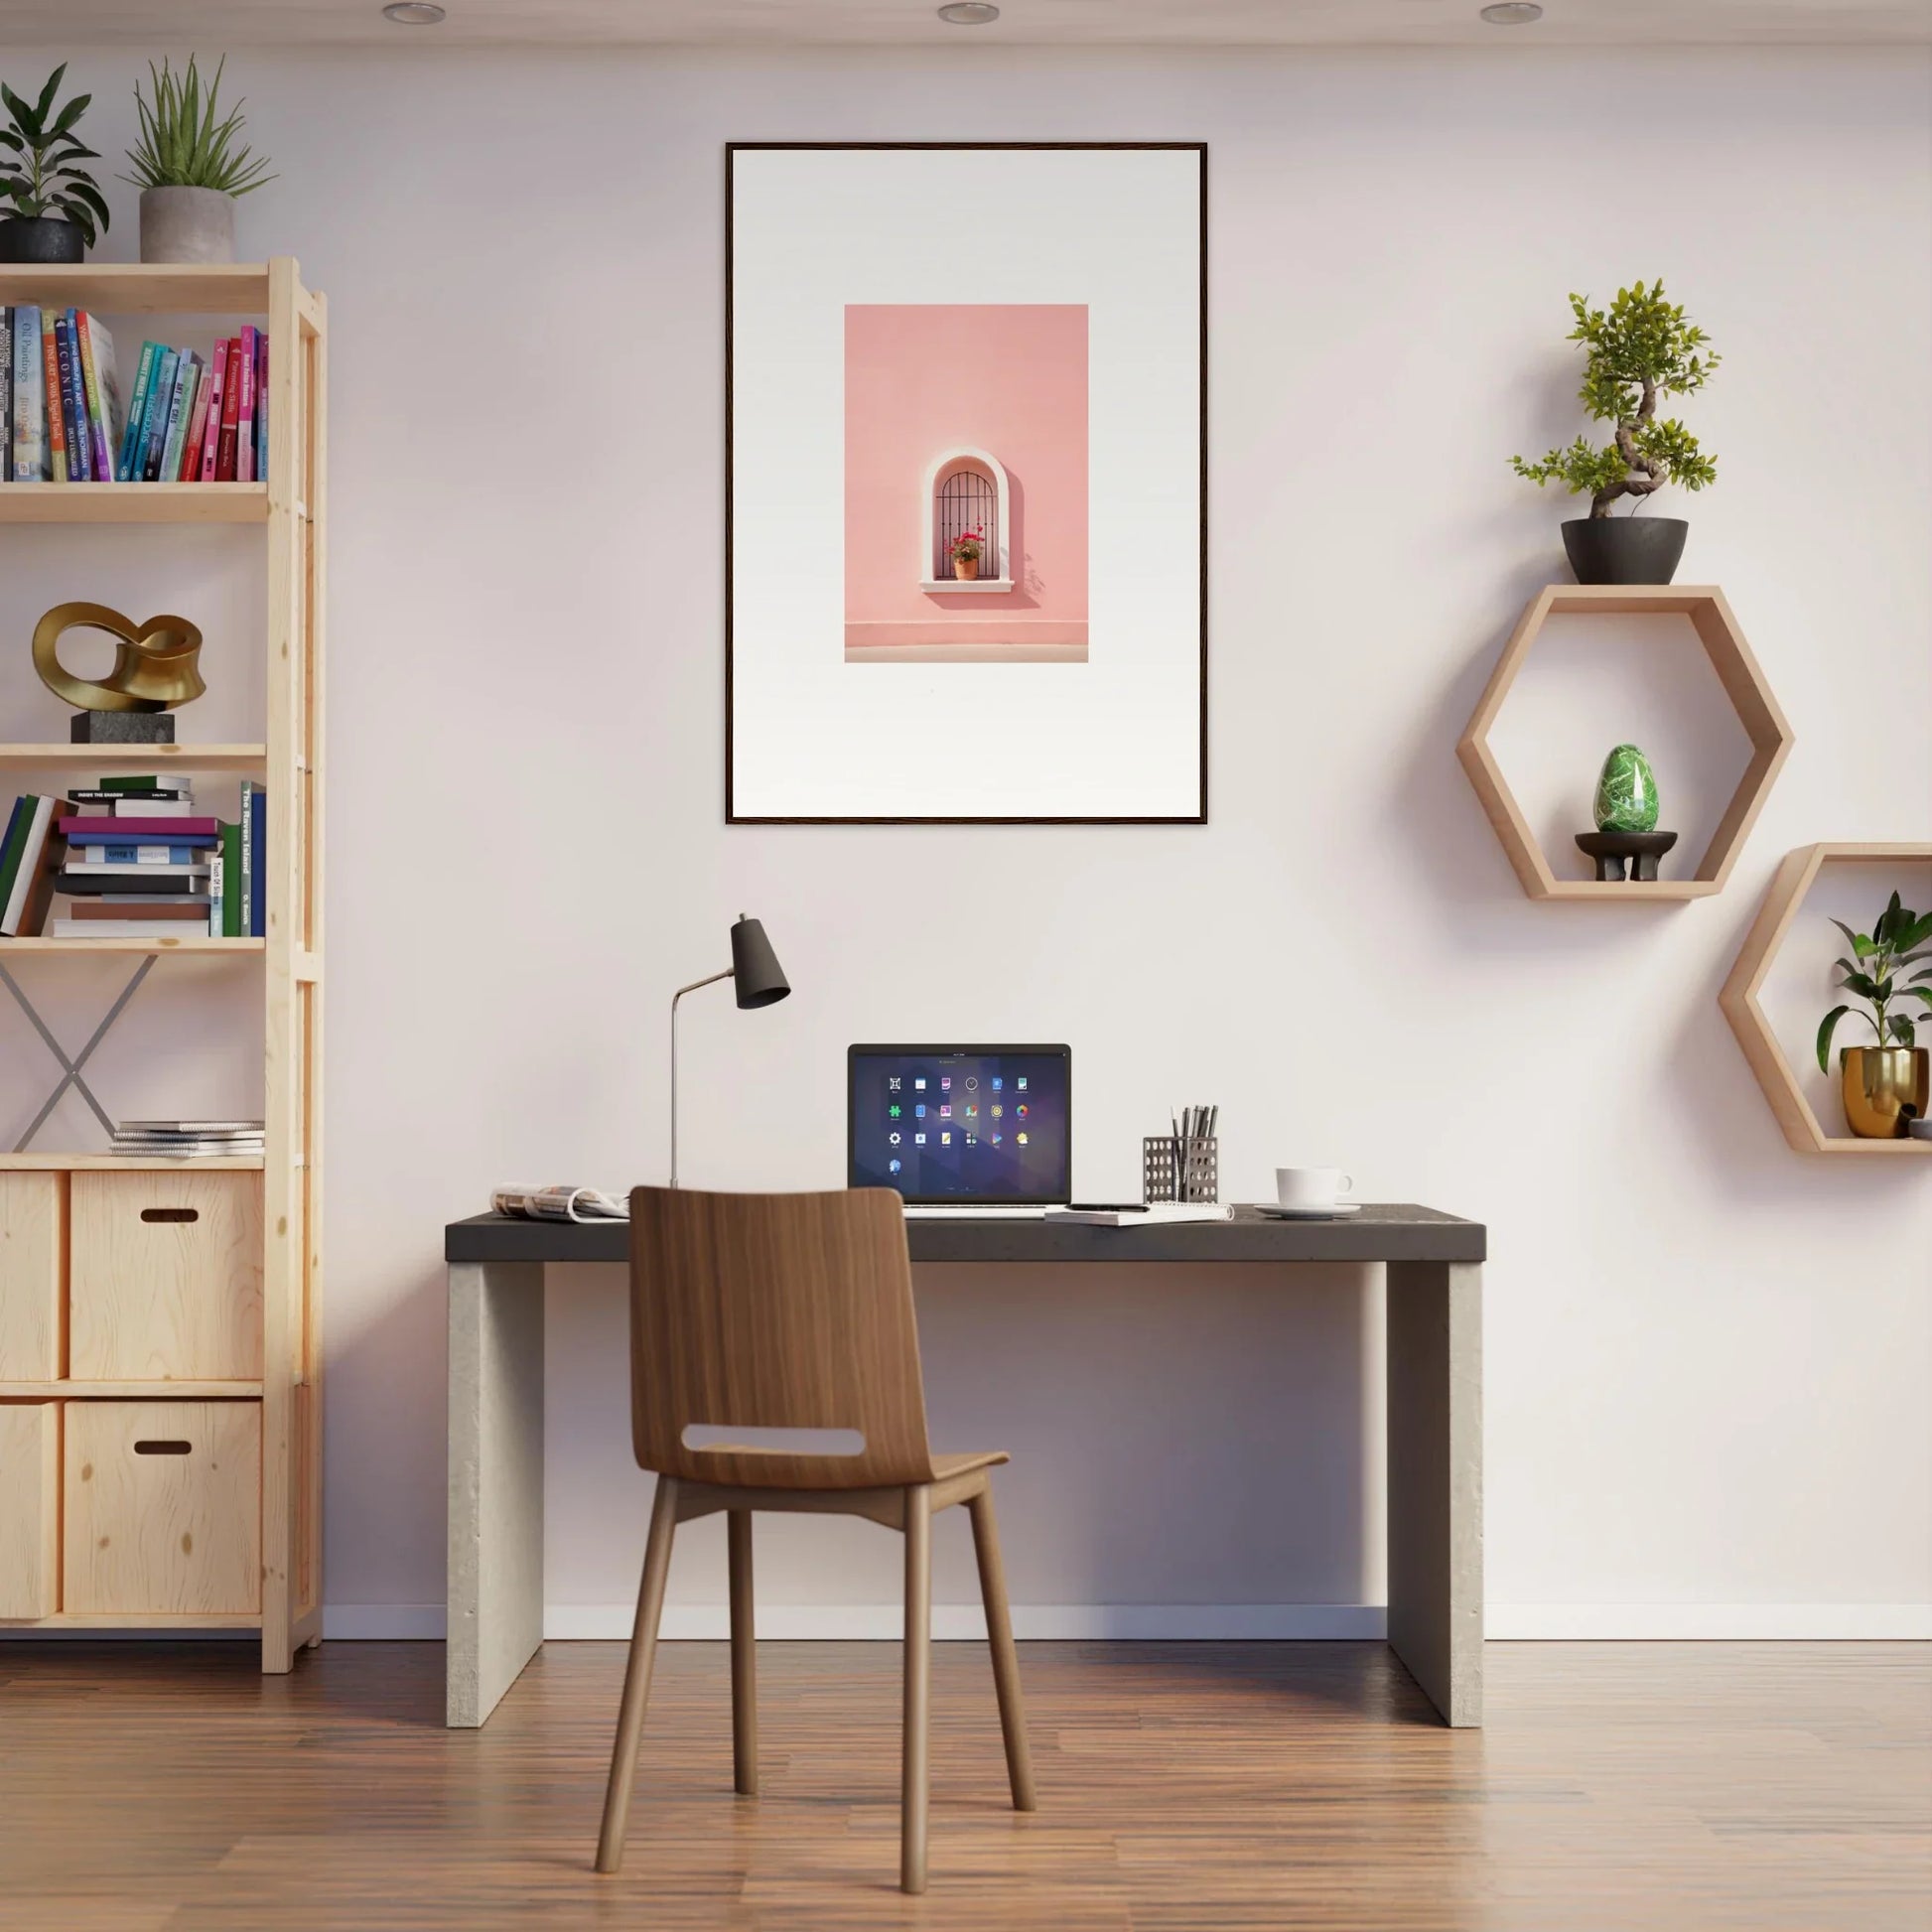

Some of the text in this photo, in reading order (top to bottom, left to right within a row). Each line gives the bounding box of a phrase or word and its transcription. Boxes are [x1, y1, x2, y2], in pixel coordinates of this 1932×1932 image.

[17, 323, 33, 383] Oil Paintings
[58, 342, 72, 405] ICONIC
[51, 399, 62, 421] Digital
[86, 372, 96, 408] Portraits
[227, 360, 239, 413] Parenting Skills
